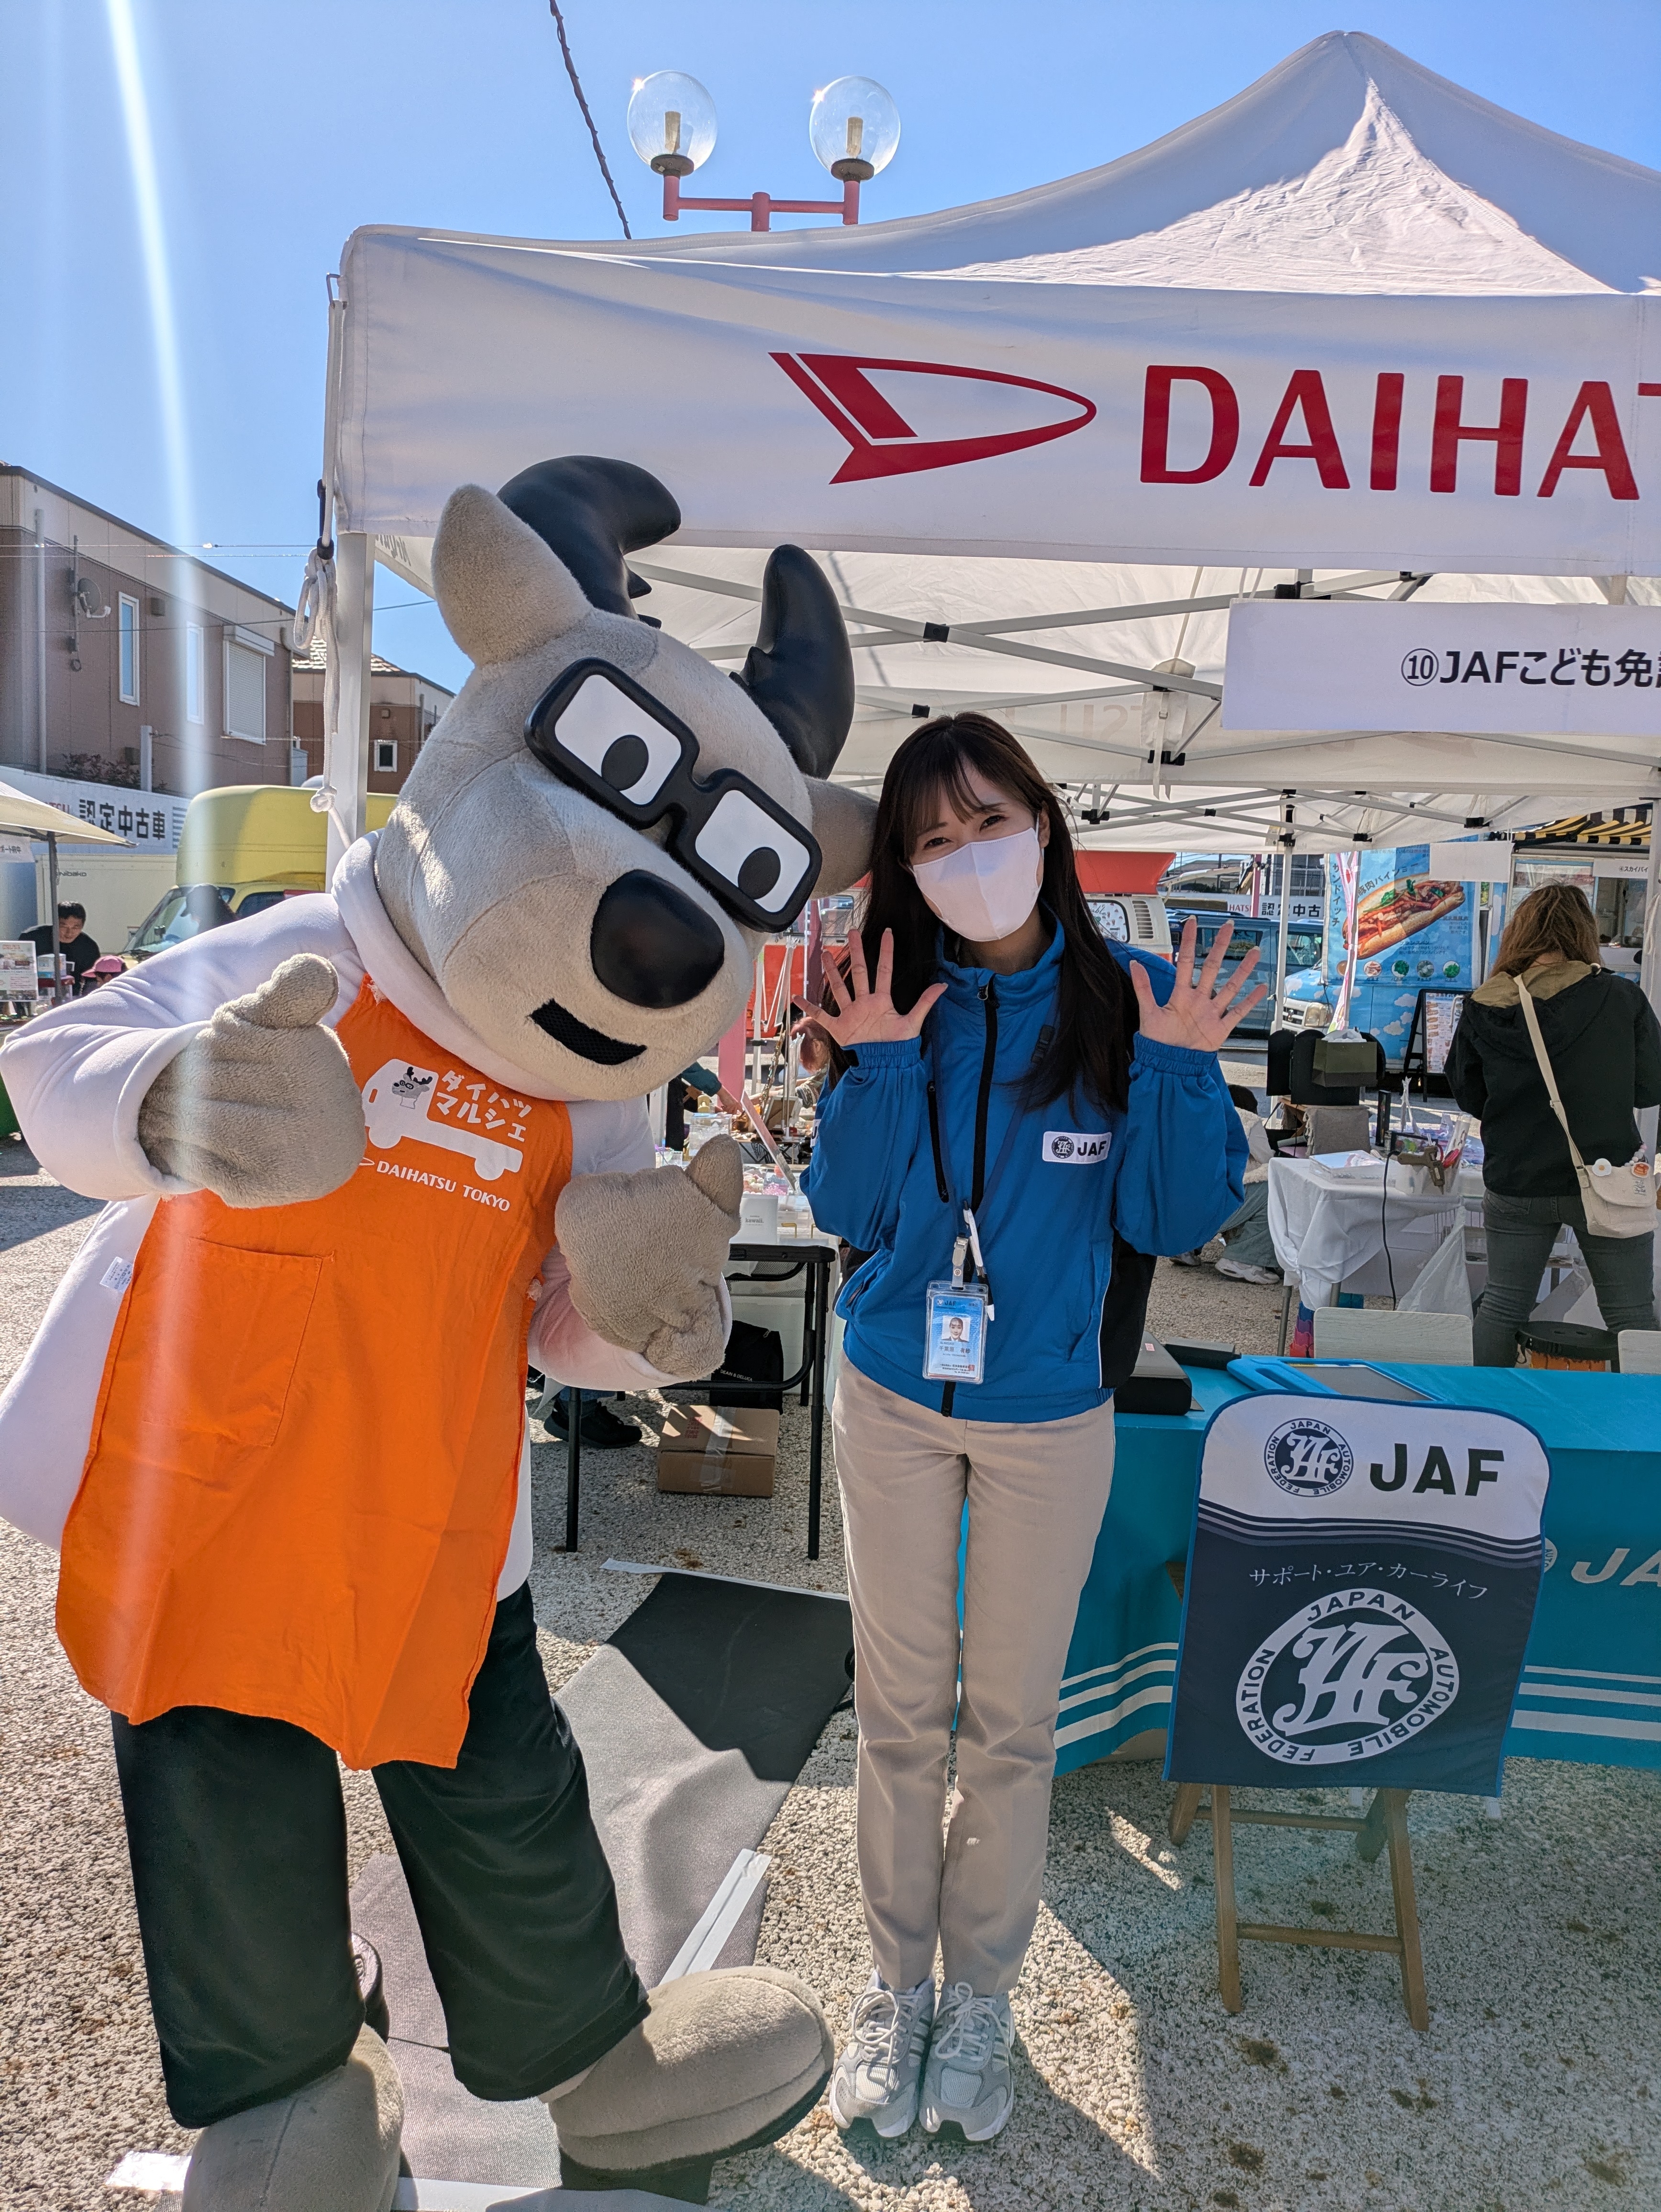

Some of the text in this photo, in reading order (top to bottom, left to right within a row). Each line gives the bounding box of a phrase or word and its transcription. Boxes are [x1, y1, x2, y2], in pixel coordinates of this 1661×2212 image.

[1141, 365, 1661, 500] DAIHA
[1401, 648, 1661, 688] ⑩JAFこども免
[1358, 863, 1418, 898] 豚肉バインミー
[1229, 904, 1251, 912] HATS
[436, 1092, 526, 1142] マルシェ
[442, 1070, 532, 1118] ダイハツ
[1077, 1140, 1107, 1156] JAF
[376, 1160, 510, 1212] DAIHATSU TOKYO
[1267, 1421, 1351, 1495] JAPAN AUTOMOBILE FEDERATION
[1369, 1442, 1505, 1497] JAF
[1249, 1561, 1488, 1599] サポート・ユア・カーライフ
[1241, 1591, 1455, 1761] JAPAN AUTOMOBILE FEDERATION
